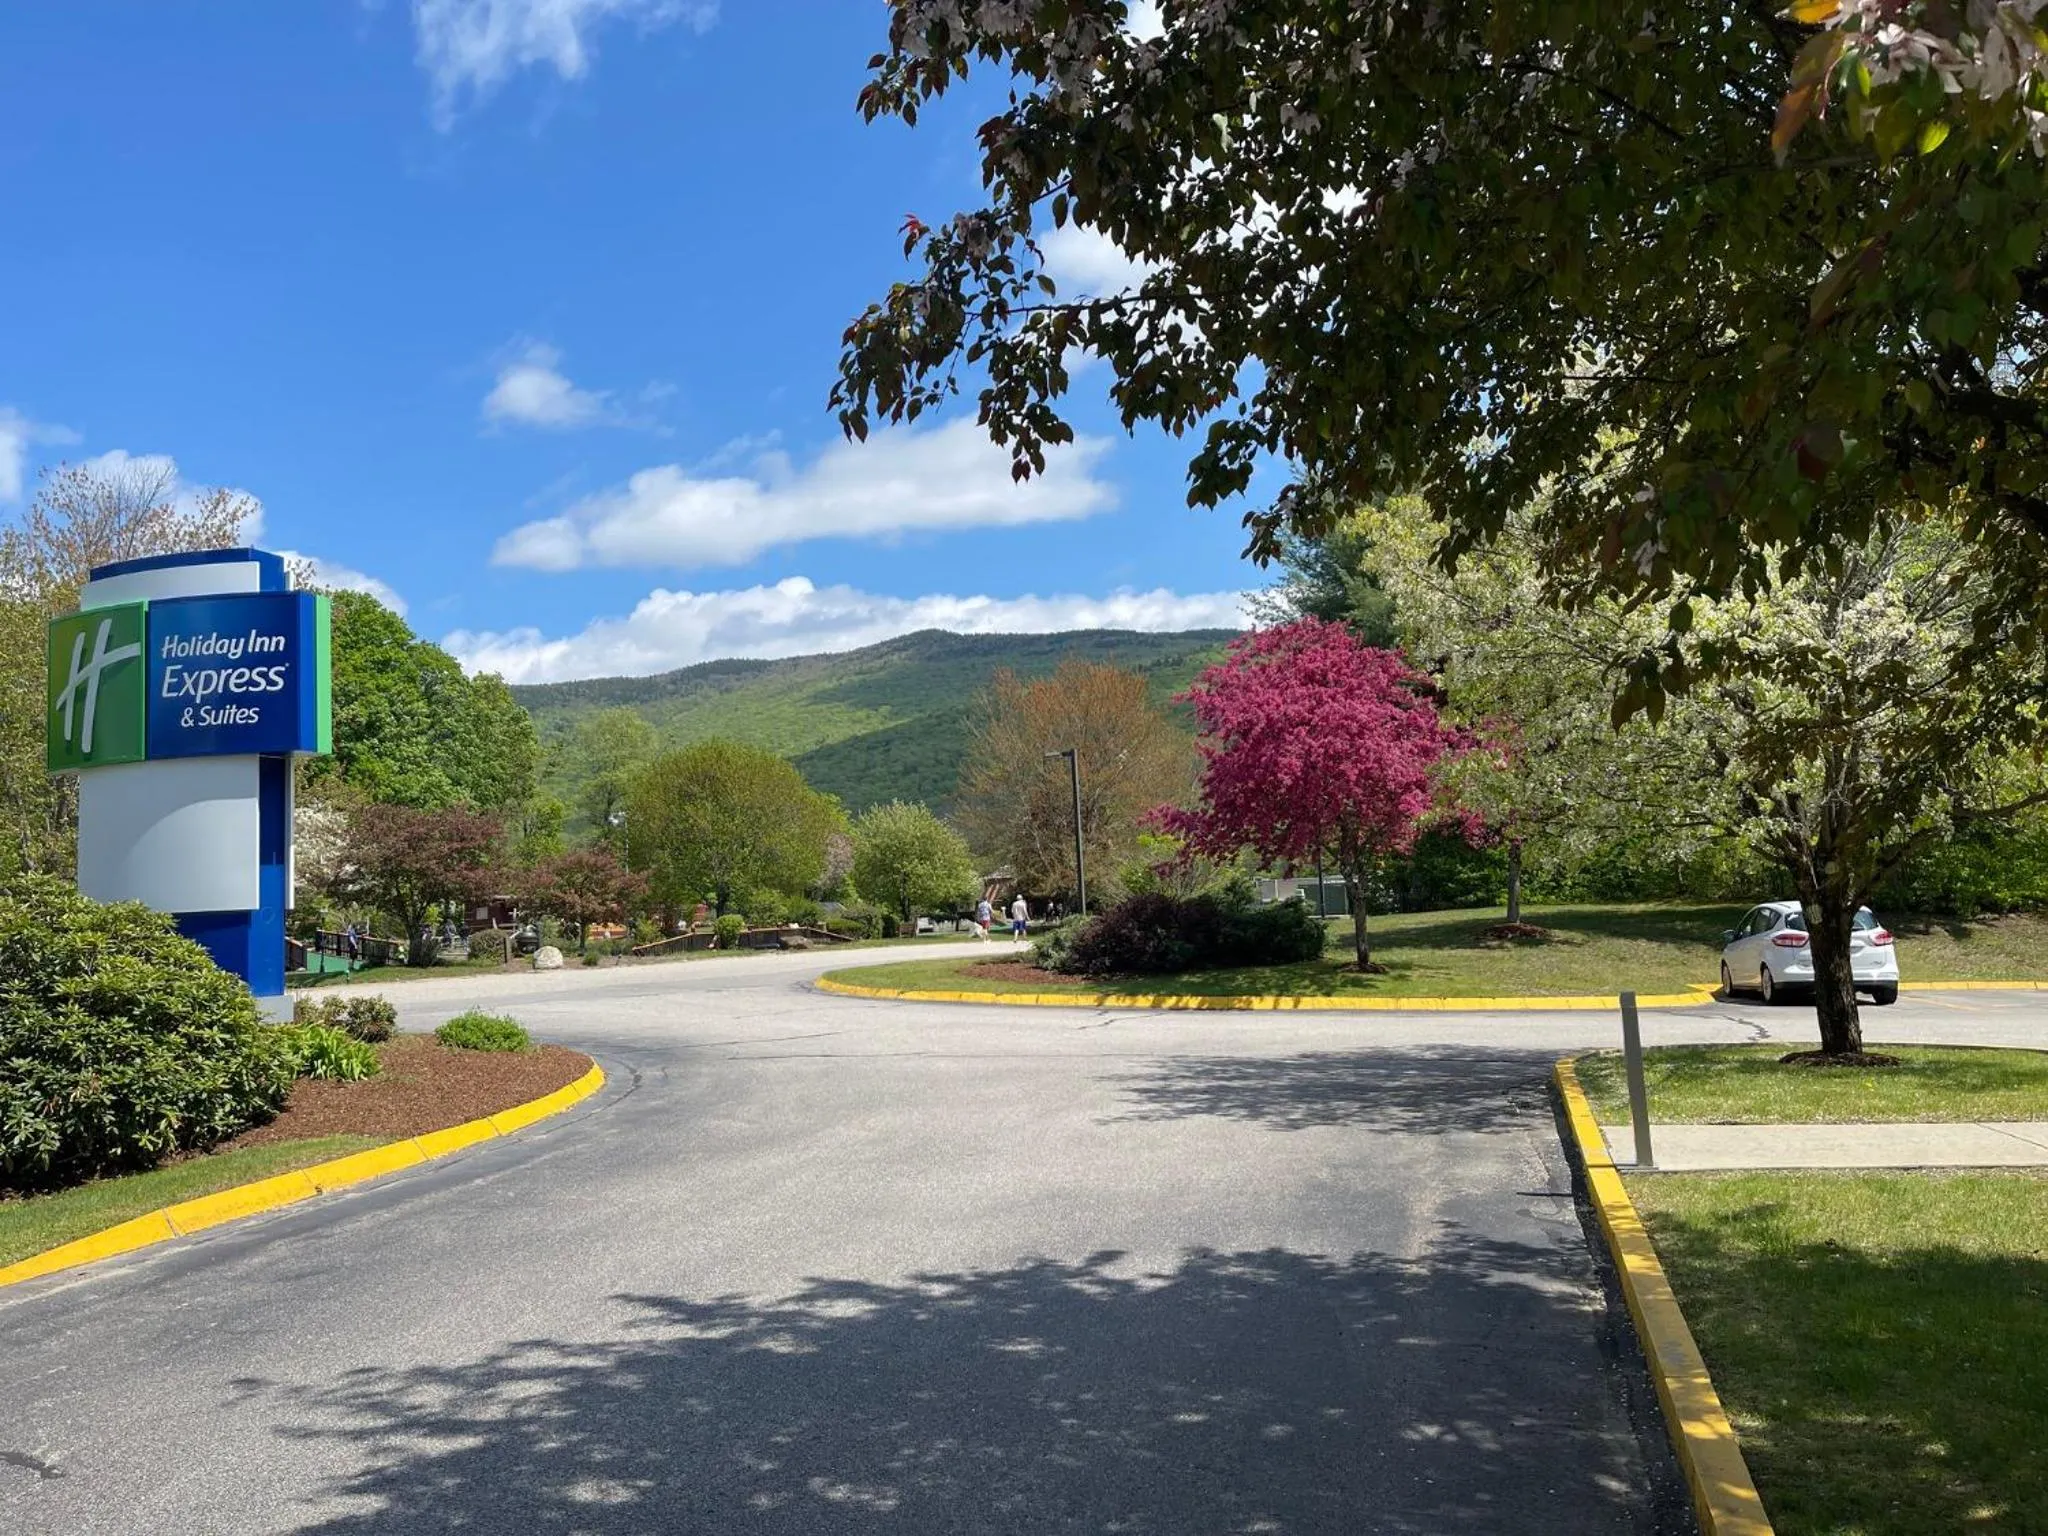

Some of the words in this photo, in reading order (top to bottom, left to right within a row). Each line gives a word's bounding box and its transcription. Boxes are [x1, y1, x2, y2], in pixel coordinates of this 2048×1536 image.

[161, 632, 246, 660] Holiday
[248, 629, 286, 653] Inn
[161, 664, 286, 704] Express
[180, 706, 195, 728] &
[197, 704, 260, 727] Suites
